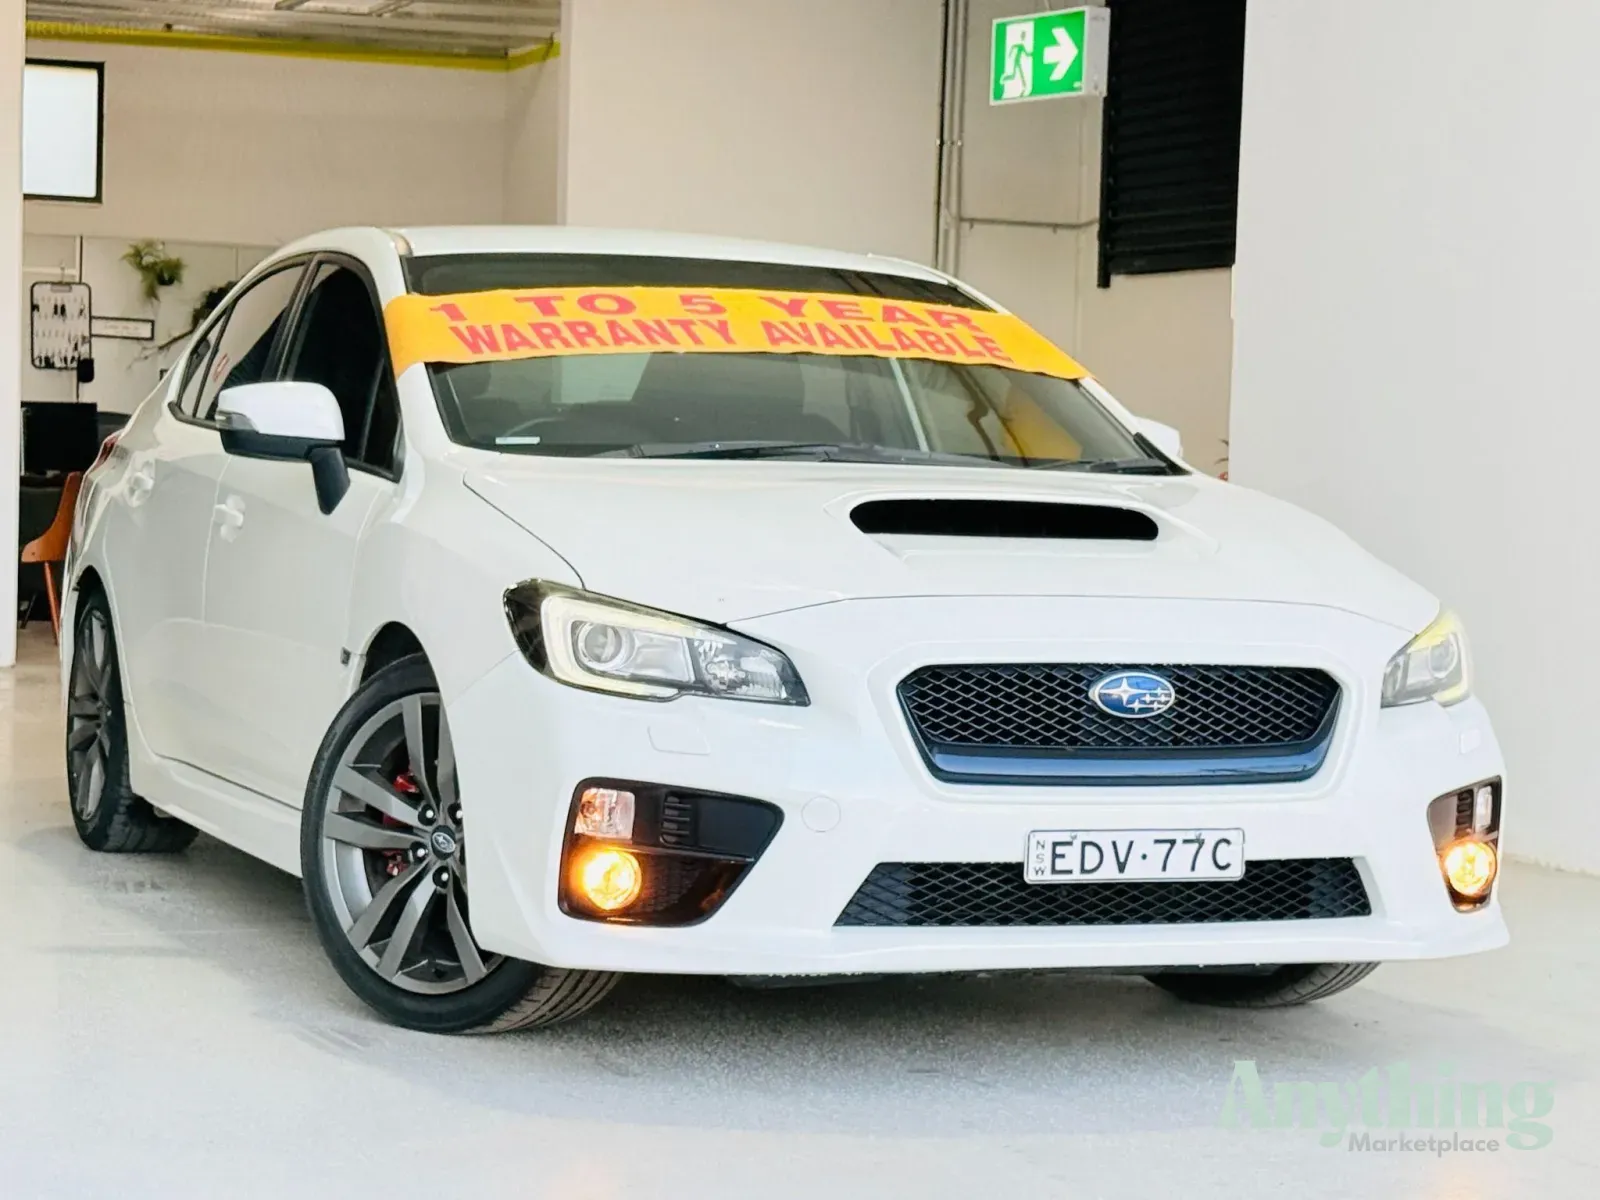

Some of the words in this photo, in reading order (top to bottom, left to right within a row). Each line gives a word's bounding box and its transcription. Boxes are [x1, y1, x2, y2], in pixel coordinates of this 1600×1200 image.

[430, 302, 467, 322] 1
[514, 293, 637, 317] TO
[679, 294, 727, 316] 5
[759, 296, 984, 333] YEAR
[448, 319, 737, 355] WARRANTY
[760, 320, 1015, 364] AVAILABLE
